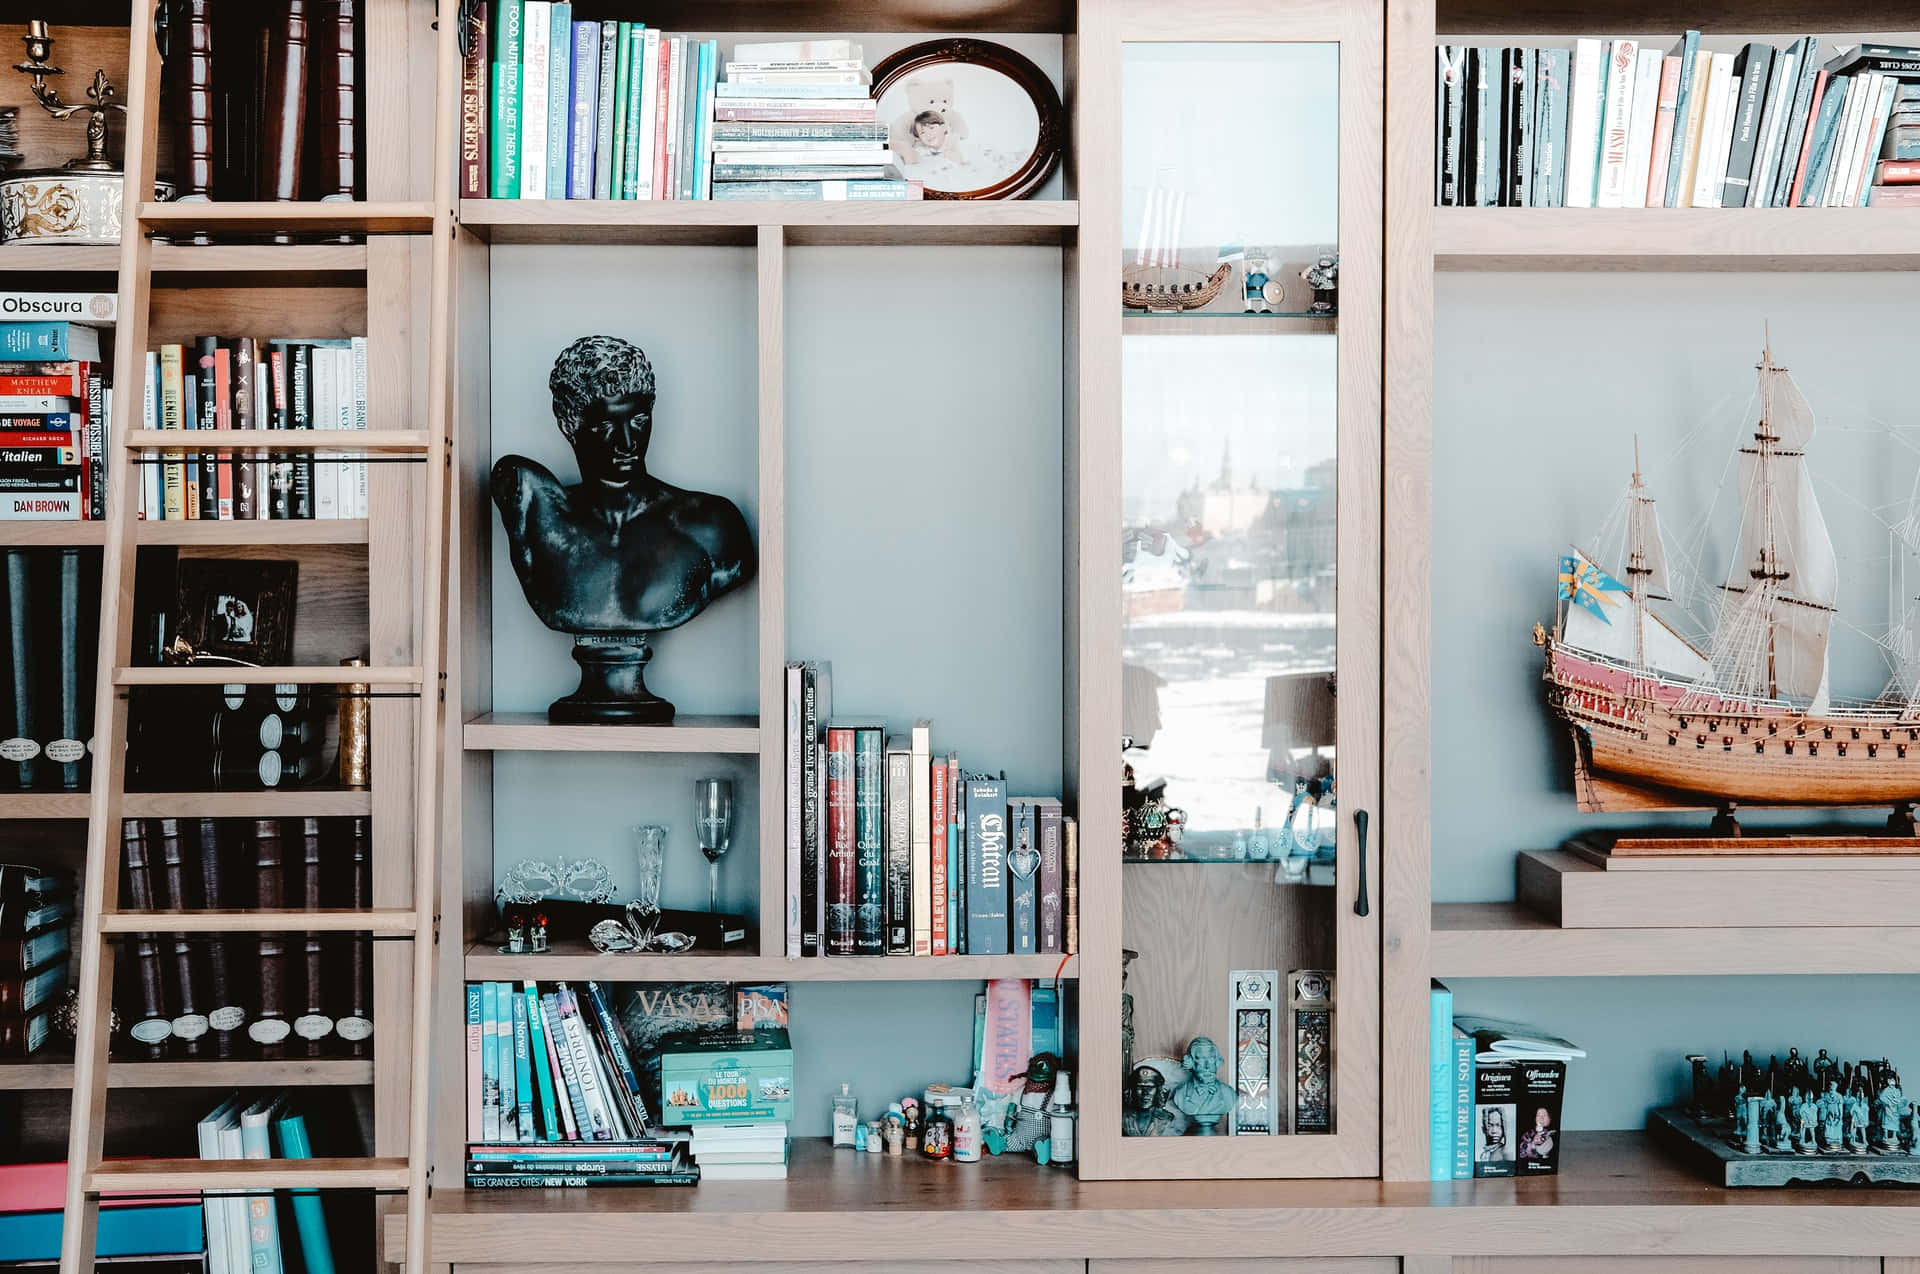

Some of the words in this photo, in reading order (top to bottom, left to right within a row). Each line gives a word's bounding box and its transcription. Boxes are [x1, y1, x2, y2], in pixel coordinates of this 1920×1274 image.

[509, 5, 520, 42] FOOD,
[508, 42, 519, 95] NUTRITION
[600, 41, 611, 94] CHINESE
[508, 96, 518, 105] &
[463, 94, 479, 161] SECRETS
[507, 107, 518, 130] DIET
[505, 131, 516, 179] THERAPY
[3, 297, 82, 313] Obscura
[355, 342, 367, 399] UNCONSCIOUS
[90, 377, 101, 417] MISSION
[294, 361, 308, 422] Accountant's
[2, 419, 12, 427] DE
[13, 418, 41, 427] VOYAGE
[90, 417, 102, 463] POSSIBLE
[0, 451, 43, 462] 'italien
[14, 500, 33, 513] DAN
[35, 500, 70, 513] BROWN
[805, 687, 816, 722] pirates
[805, 724, 815, 742] des
[805, 744, 815, 768] livre
[805, 769, 817, 798] grand
[805, 801, 815, 814] Le
[863, 849, 875, 858] du
[976, 813, 1007, 889] Château
[933, 864, 945, 932] FLEURUS
[469, 991, 480, 1024] ULYSSE
[528, 994, 540, 1030] FLORIDE
[635, 990, 713, 1018] VASA
[740, 998, 785, 1018] PISA
[516, 1021, 528, 1060] Norway
[600, 1010, 620, 1044] Portugal
[994, 999, 1019, 1080] STATES
[556, 1042, 578, 1084] ROME
[570, 1023, 597, 1093] LONDRES
[1457, 1047, 1471, 1081] SOIR
[723, 1070, 739, 1078] TOUR
[633, 1094, 649, 1120] ULYSSE
[707, 1084, 748, 1101] 1000
[707, 1099, 748, 1108] QUESTIONS
[1457, 1082, 1470, 1104] DU
[1457, 1105, 1469, 1147] LIVRE
[575, 1164, 606, 1173] Europe
[636, 1163, 668, 1172] ULYSSE
[1457, 1150, 1469, 1167] LE
[473, 1178, 483, 1187] LES
[483, 1178, 520, 1187] GRANDES
[564, 1177, 588, 1187] YORK
